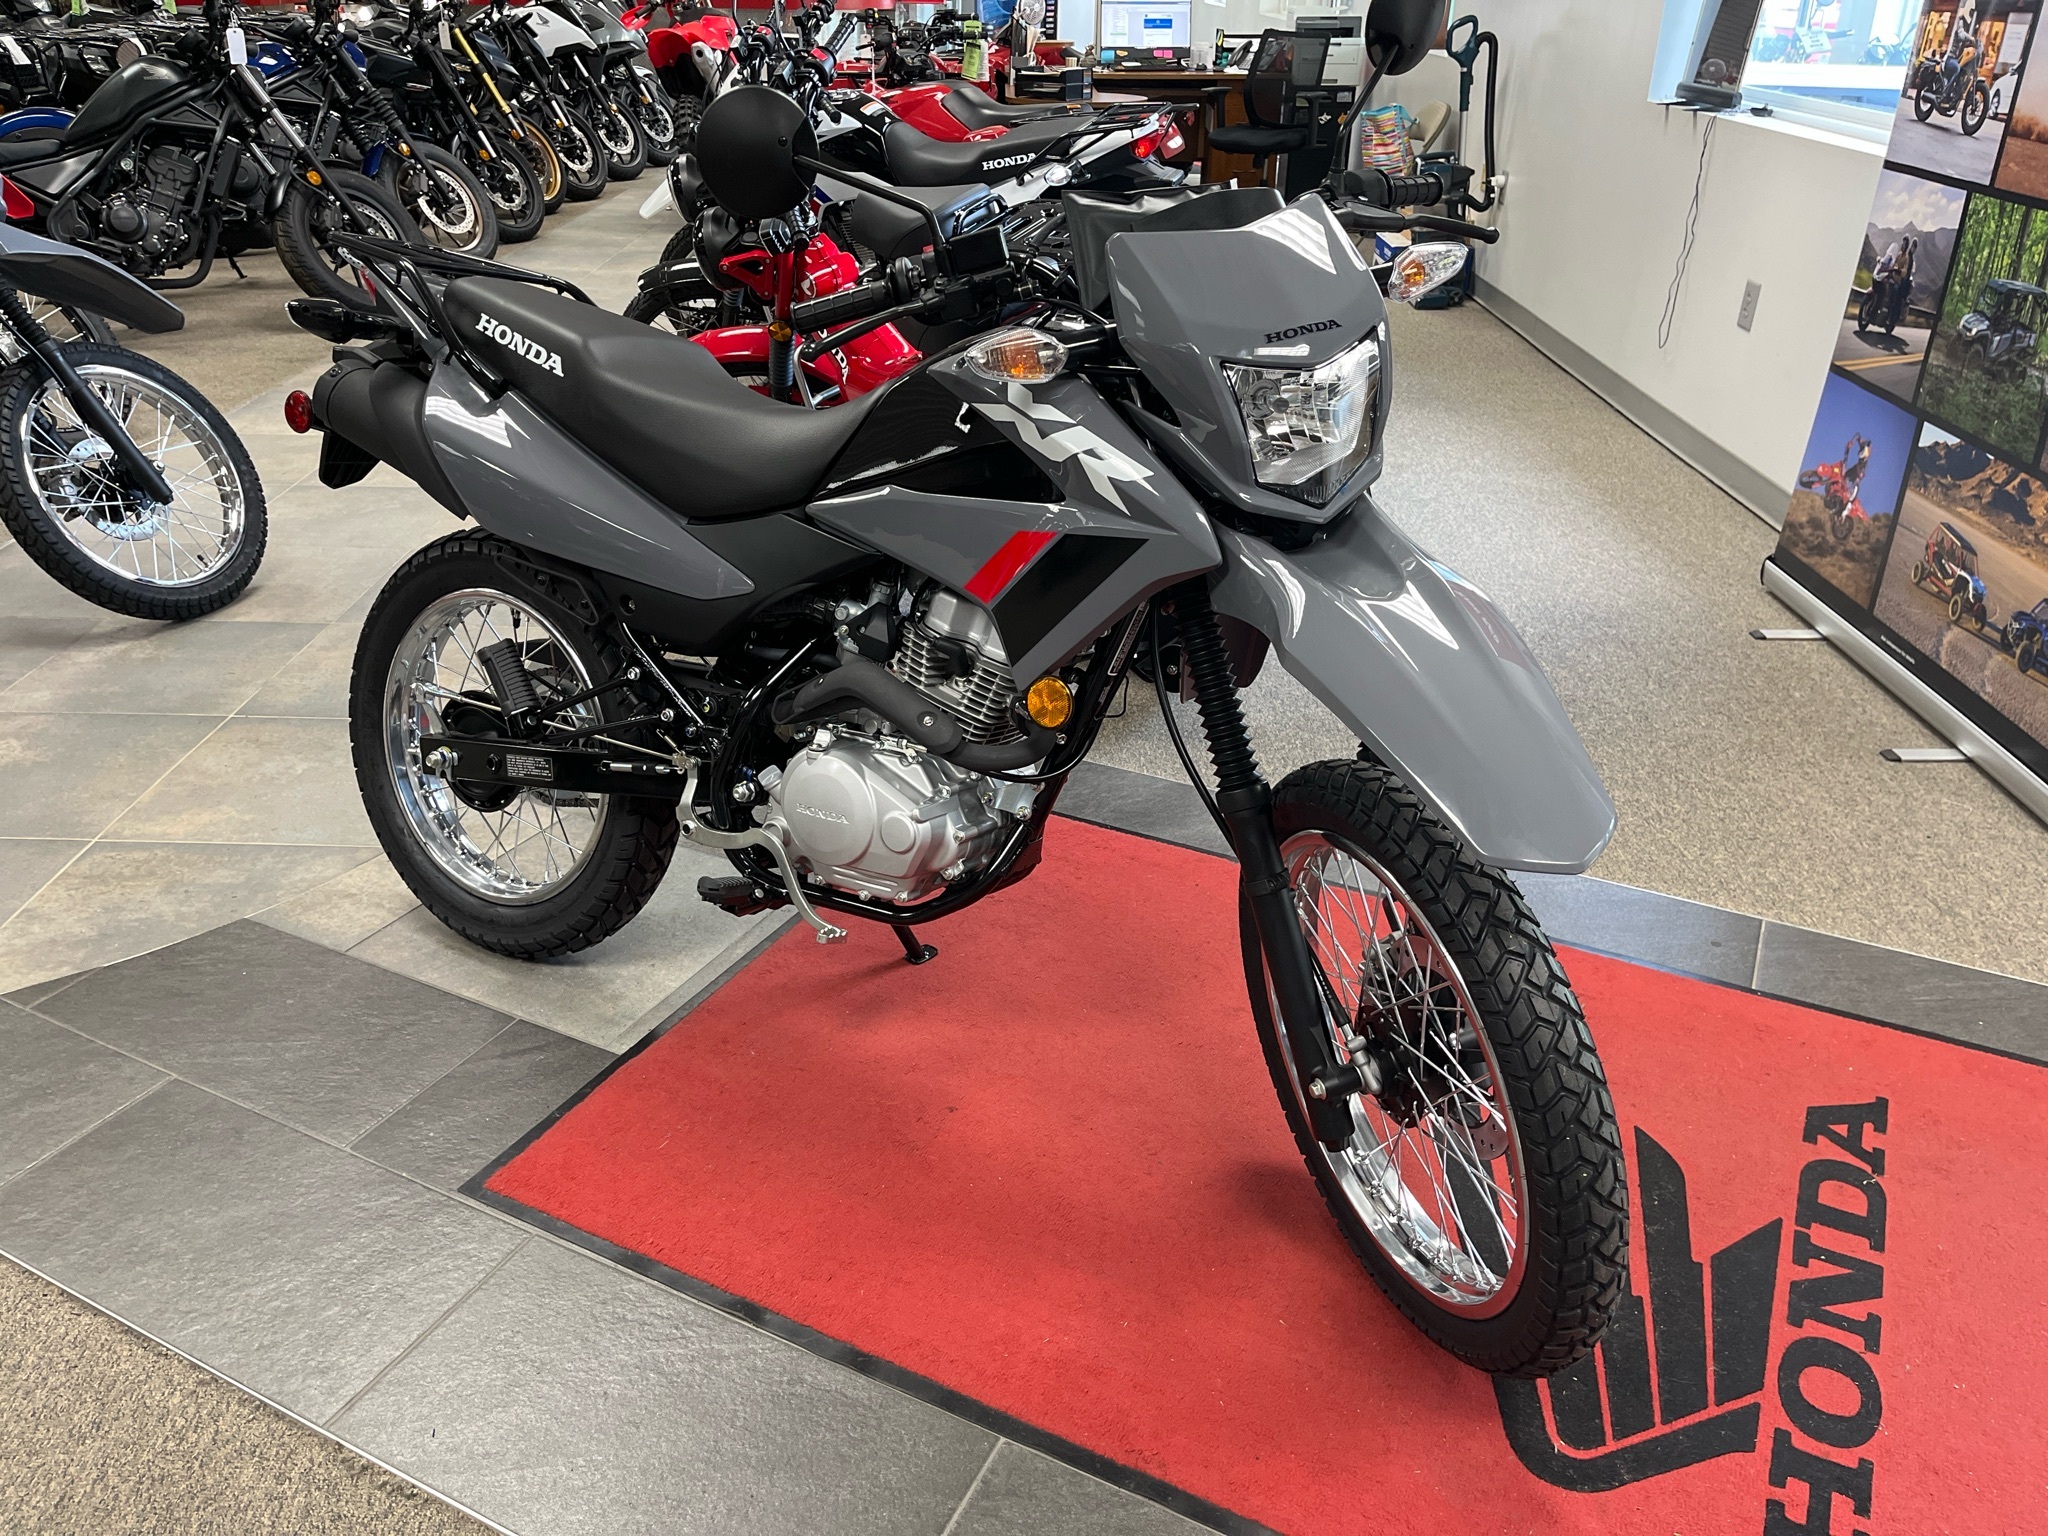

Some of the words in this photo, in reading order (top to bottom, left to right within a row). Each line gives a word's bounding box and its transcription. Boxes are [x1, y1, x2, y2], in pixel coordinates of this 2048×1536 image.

[981, 152, 1037, 171] HONDA
[475, 312, 565, 378] HONDA
[1263, 319, 1342, 344] HONDA
[971, 382, 1160, 516] XR
[796, 803, 850, 825] HONDA
[1763, 1096, 1889, 1536] HONDA
